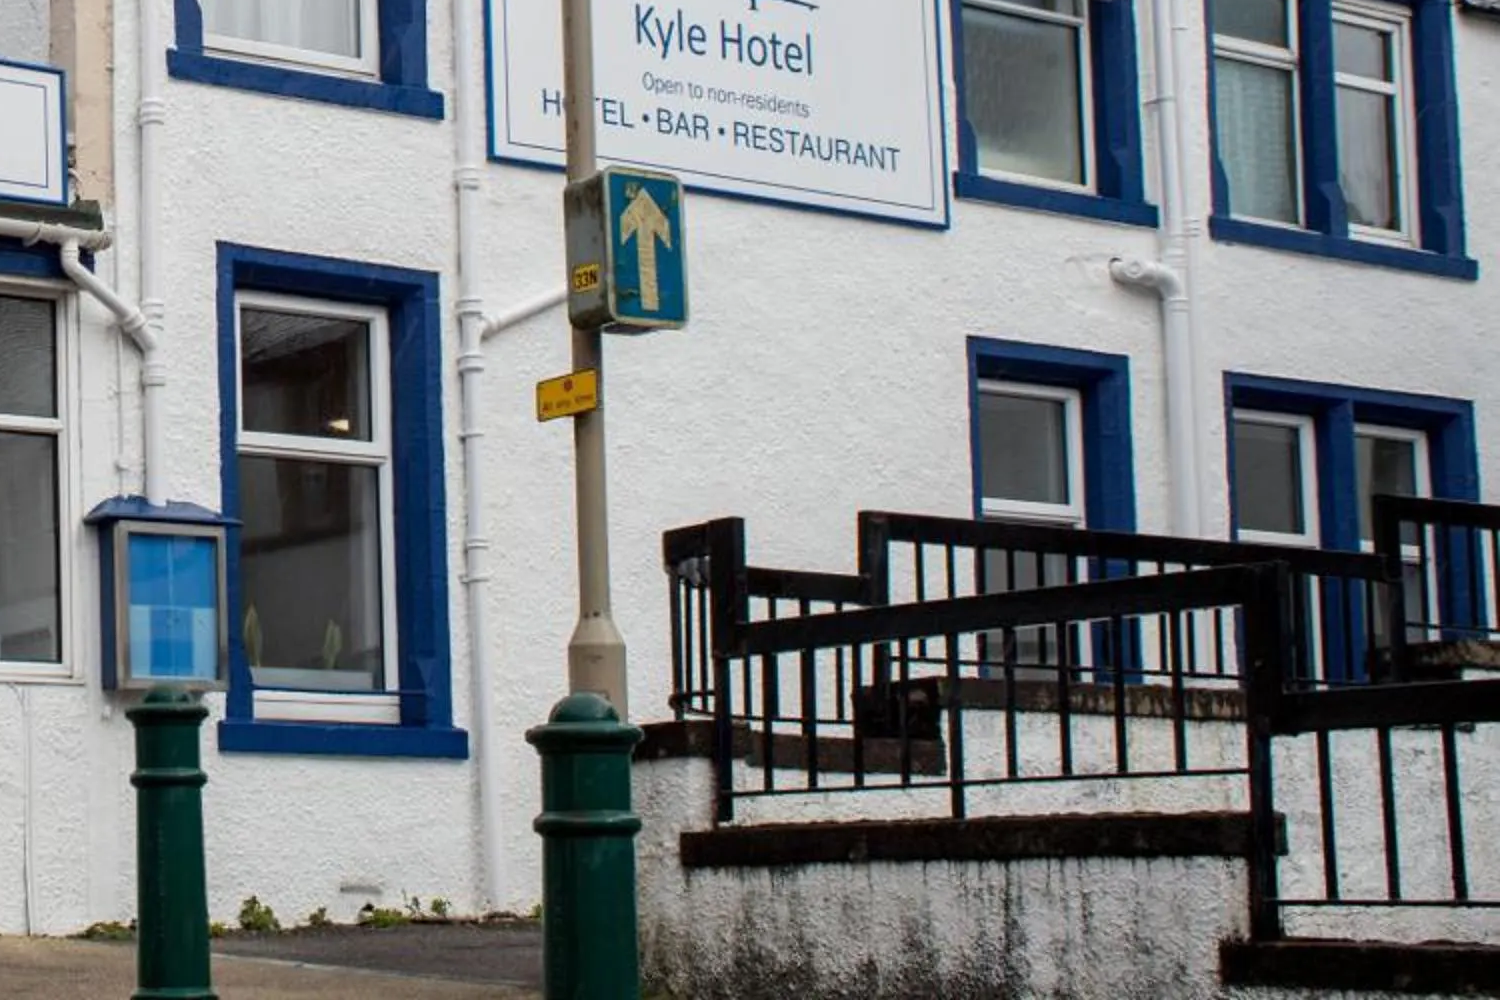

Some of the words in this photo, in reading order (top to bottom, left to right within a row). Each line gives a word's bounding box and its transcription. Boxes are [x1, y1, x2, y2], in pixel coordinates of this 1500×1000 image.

[635, 3, 707, 60] Kyle
[720, 19, 813, 76] Hotel
[542, 88, 635, 129] HEL
[656, 108, 710, 141] BAR
[733, 121, 901, 172] RESTAURANT
[642, 71, 684, 95] Open
[688, 82, 703, 99] to
[707, 87, 811, 118] non-residents
